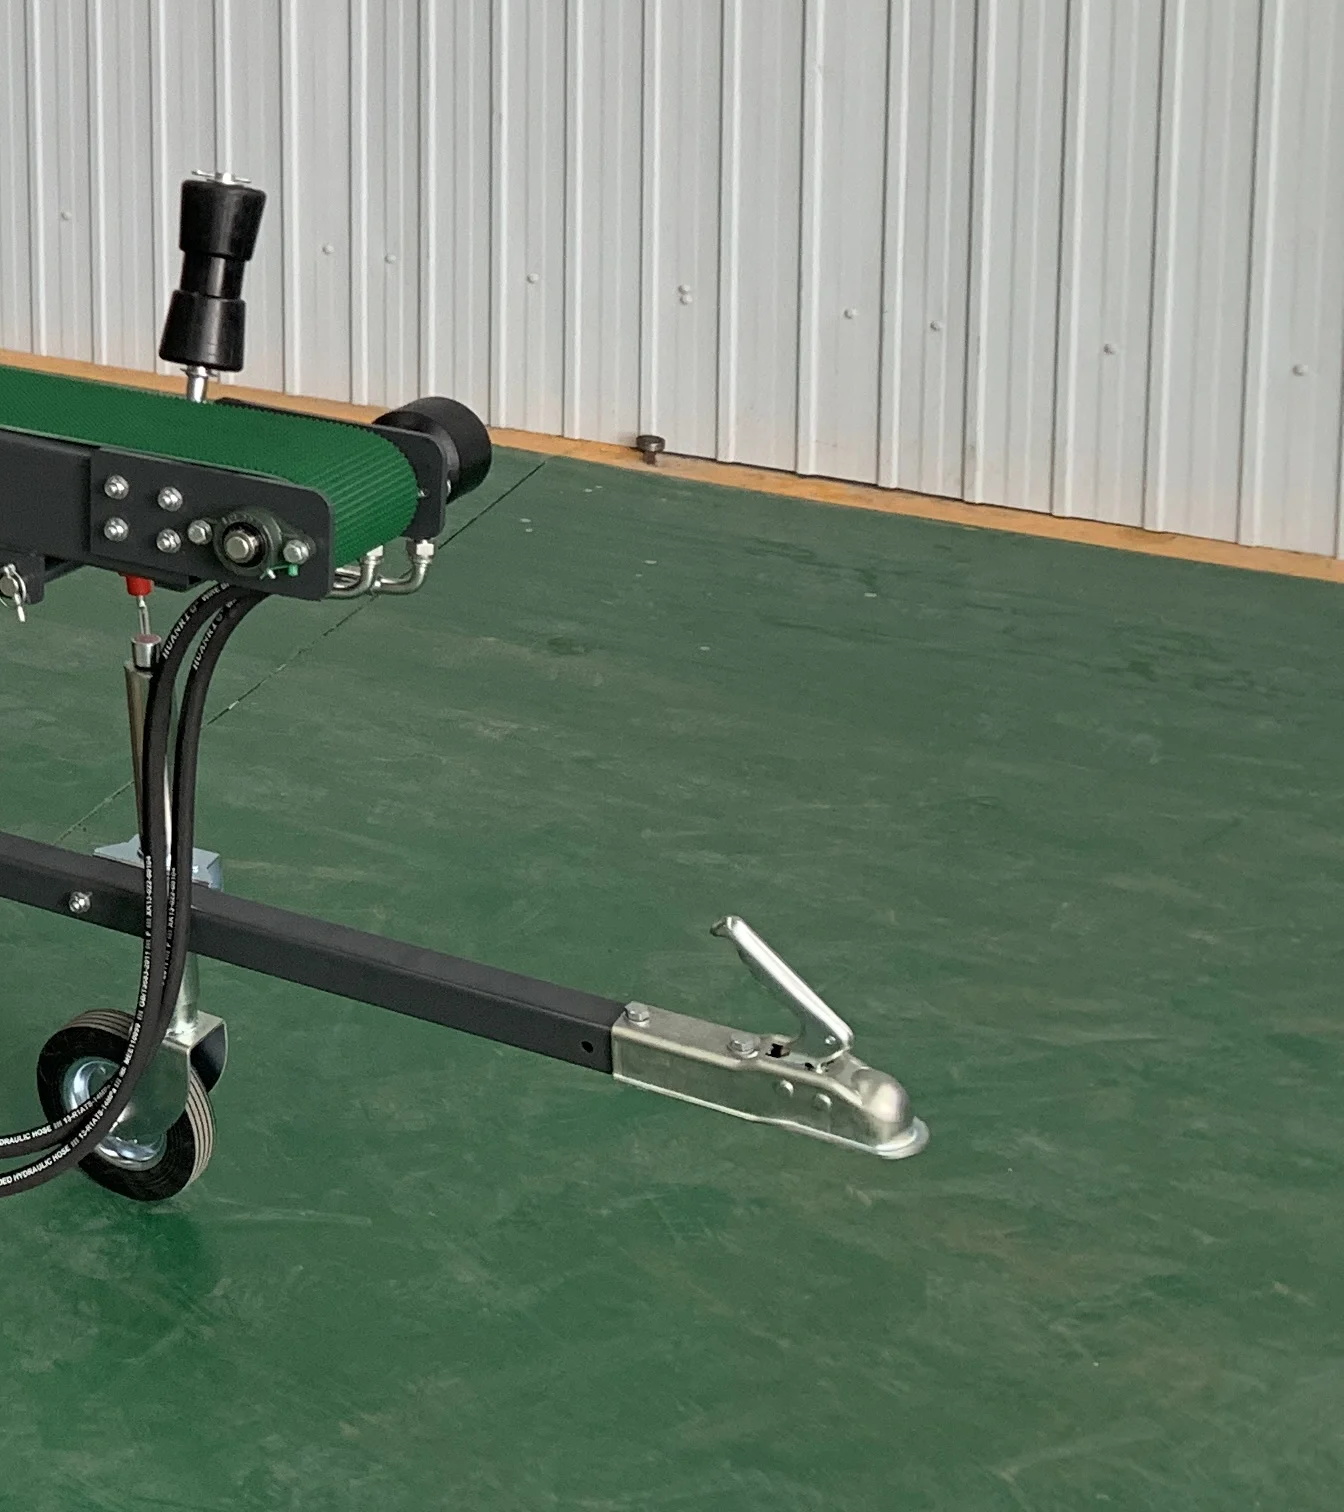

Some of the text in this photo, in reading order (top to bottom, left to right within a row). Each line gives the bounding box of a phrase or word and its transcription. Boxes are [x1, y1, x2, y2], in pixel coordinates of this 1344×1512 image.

[32, 1124, 53, 1139] HOSE
[13, 1157, 53, 1182] HYDRAULIC
[52, 1144, 72, 1165] HOSE
